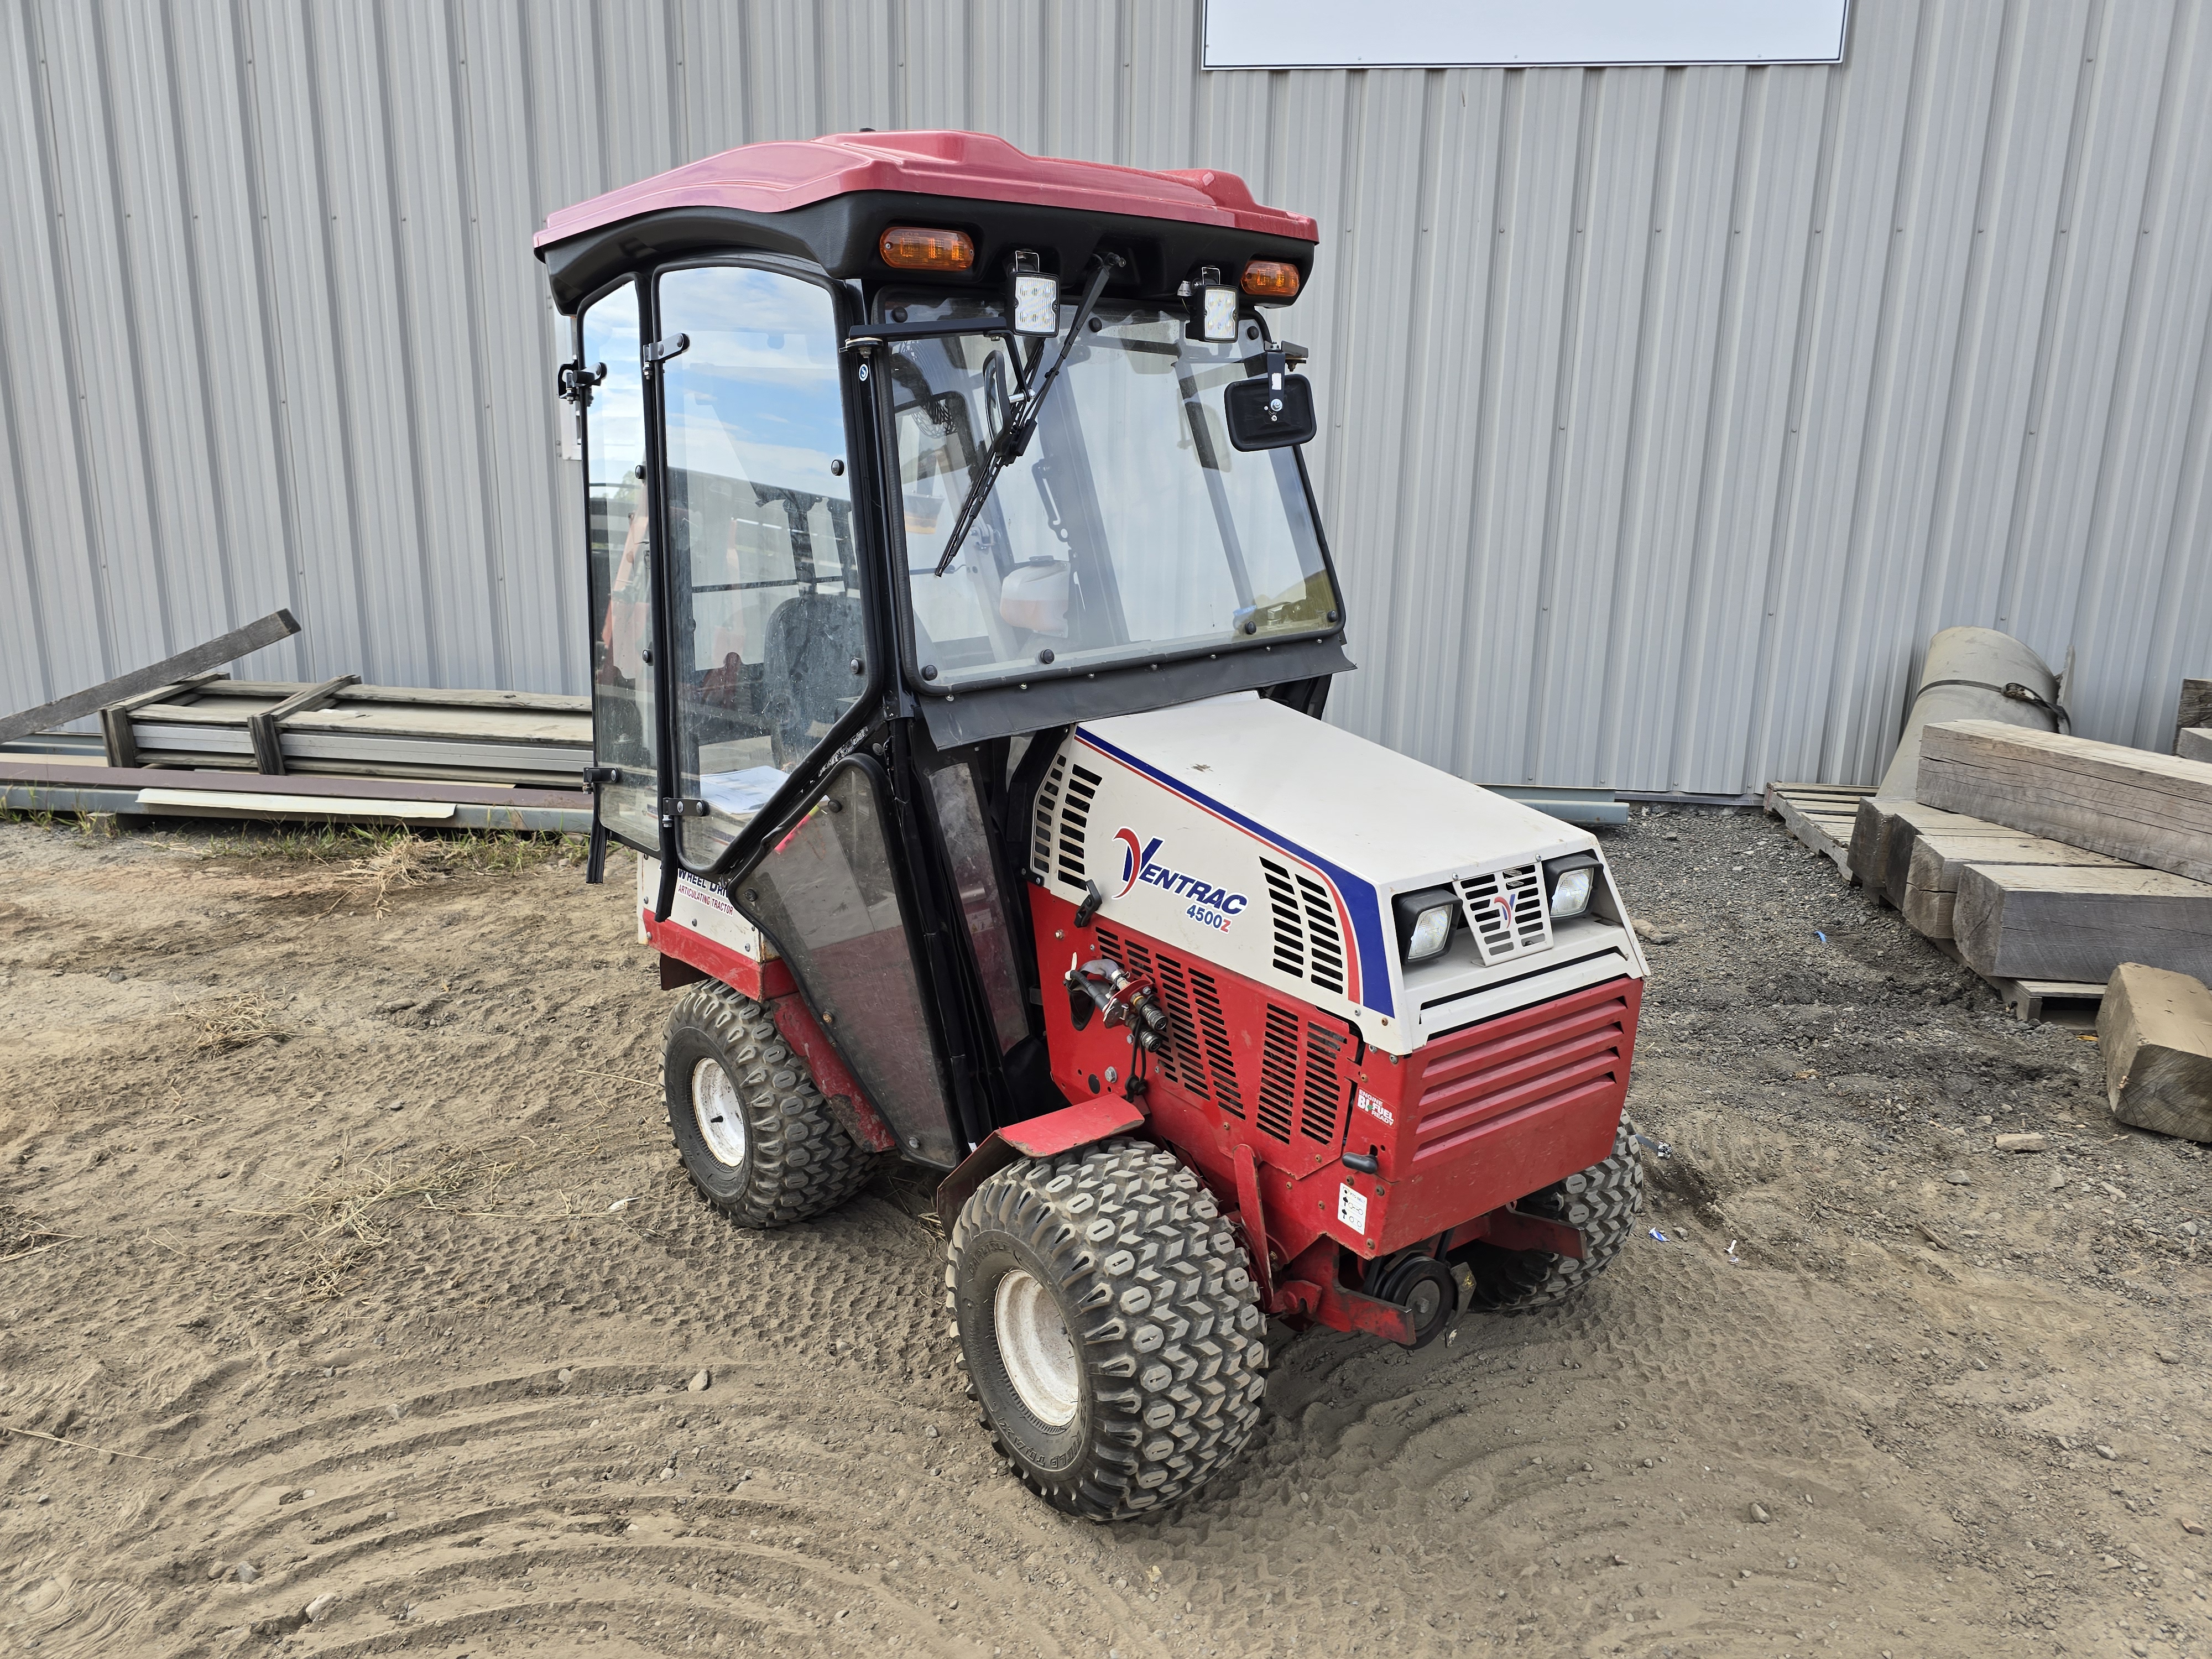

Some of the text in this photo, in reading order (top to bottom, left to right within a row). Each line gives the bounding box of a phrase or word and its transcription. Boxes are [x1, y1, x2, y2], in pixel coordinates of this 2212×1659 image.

[679, 869, 706, 889] WHEEL
[1112, 827, 1248, 915] VENTRAC
[678, 884, 733, 915] ARTICULATING TRACTOR
[1186, 905, 1231, 933] 4500Z
[1359, 1089, 1383, 1107] ENGINE
[1371, 1110, 1394, 1126] READY
[968, 1240, 1011, 1277] CARLISLE
